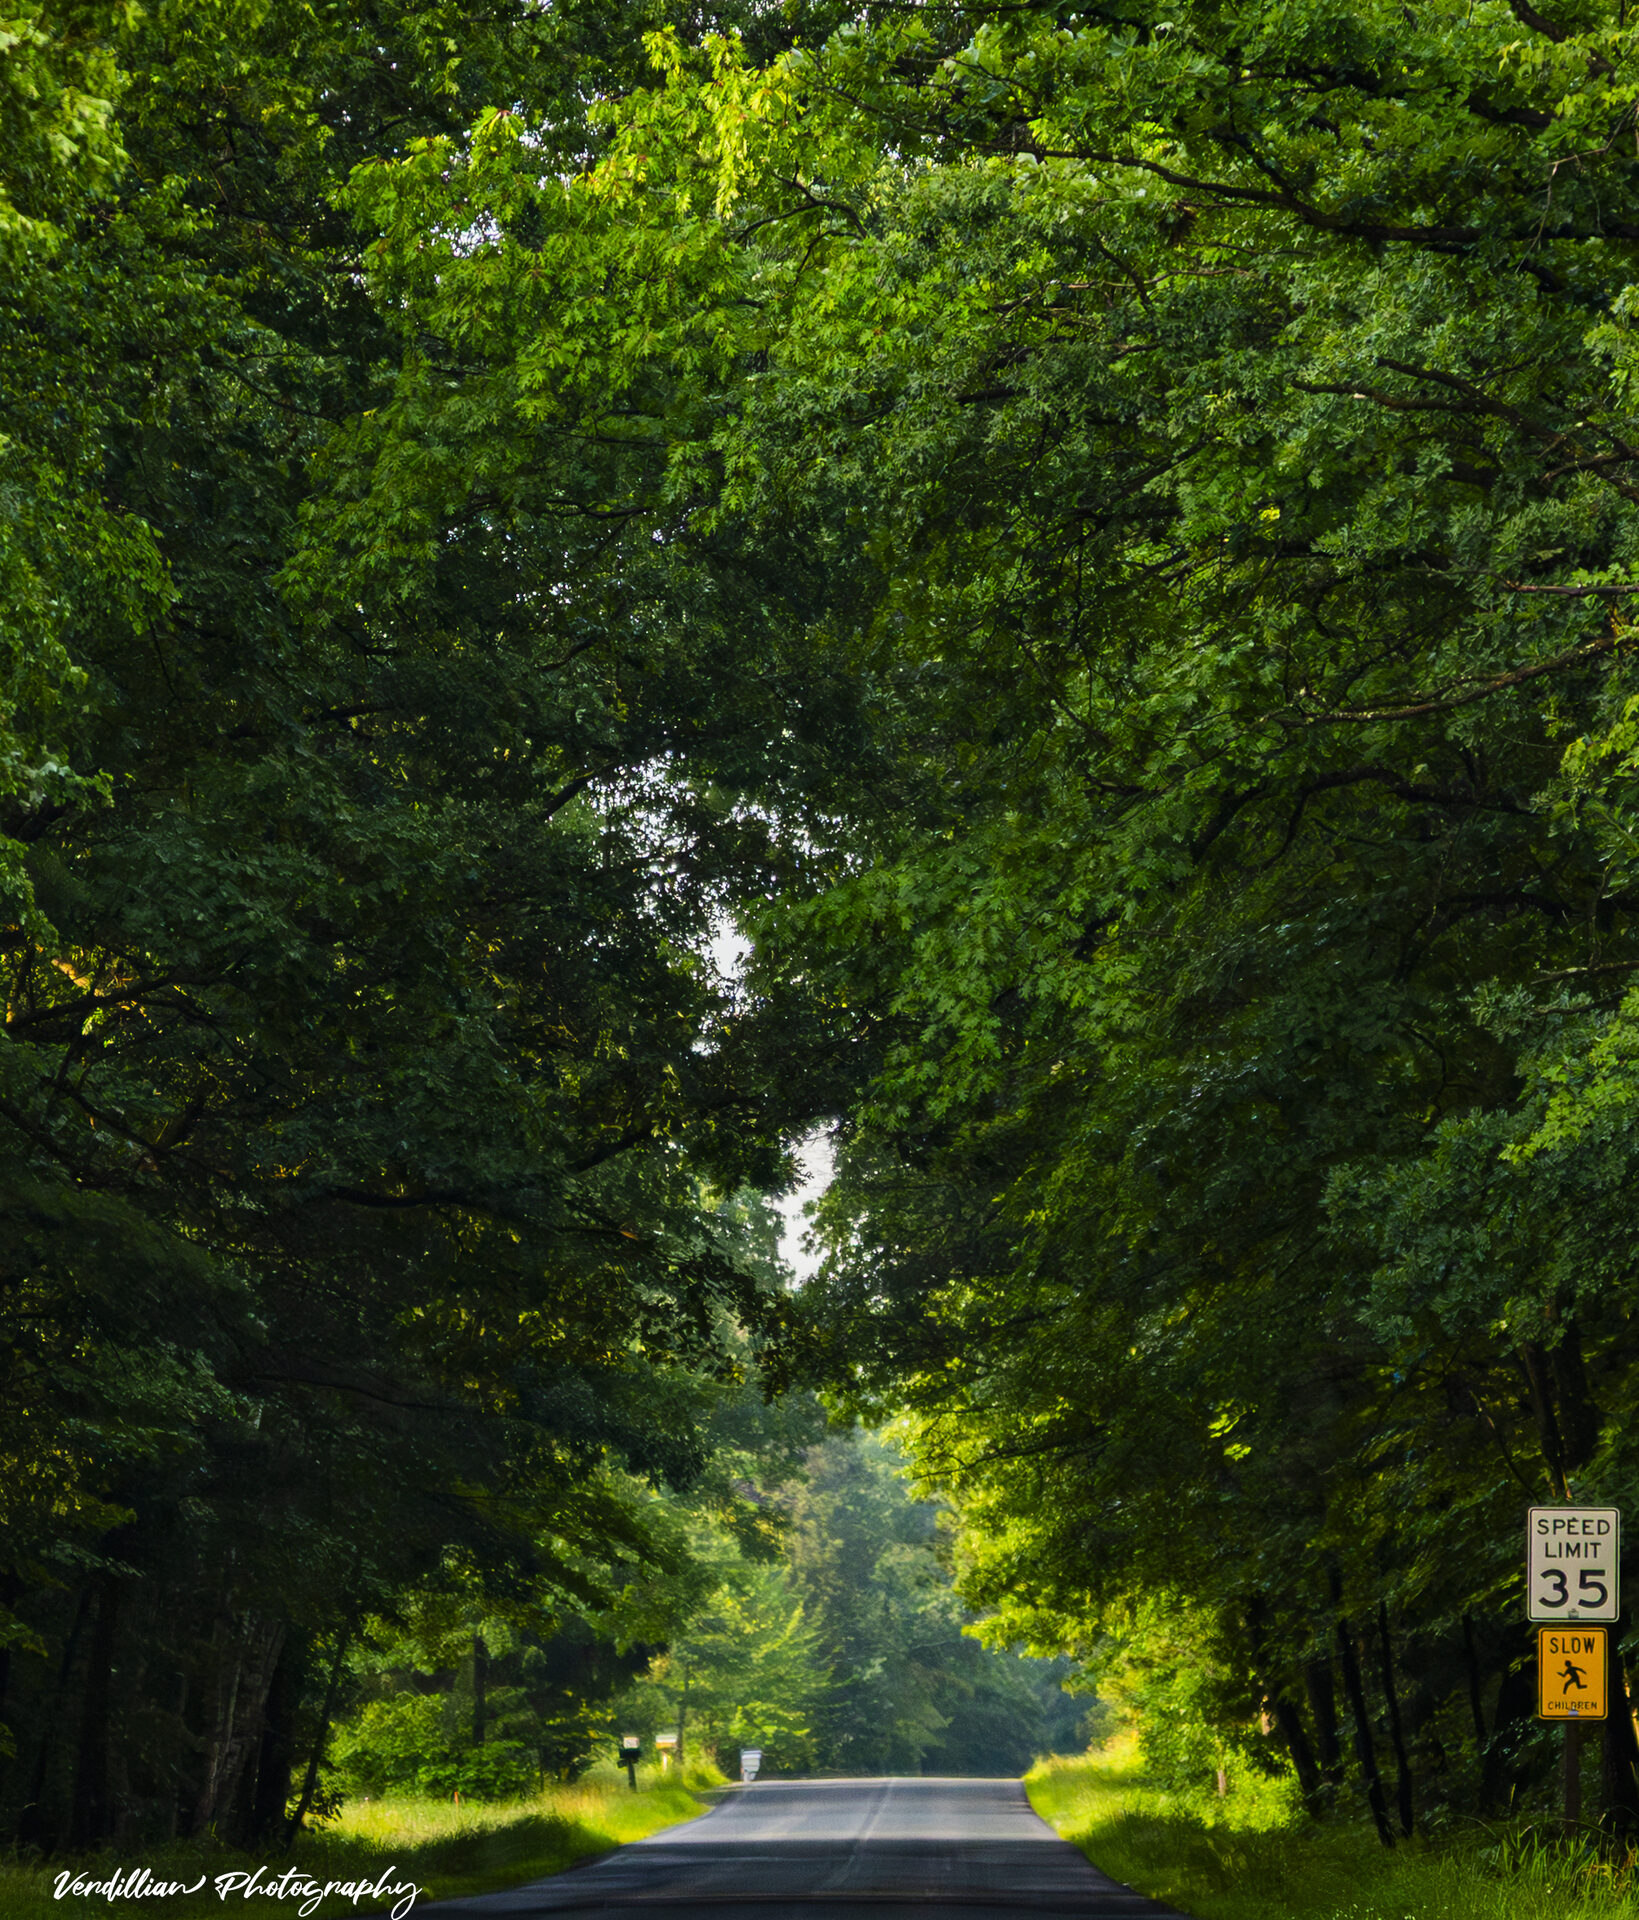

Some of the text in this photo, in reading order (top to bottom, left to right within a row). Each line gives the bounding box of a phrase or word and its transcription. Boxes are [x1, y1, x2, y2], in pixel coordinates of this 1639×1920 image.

[1537, 1518, 1610, 1535] SPEED
[1545, 1542, 1602, 1558] LIMIT
[1538, 1568, 1608, 1608] 35
[1550, 1637, 1595, 1654] SLOW
[1548, 1701, 1597, 1710] CHILDREN
